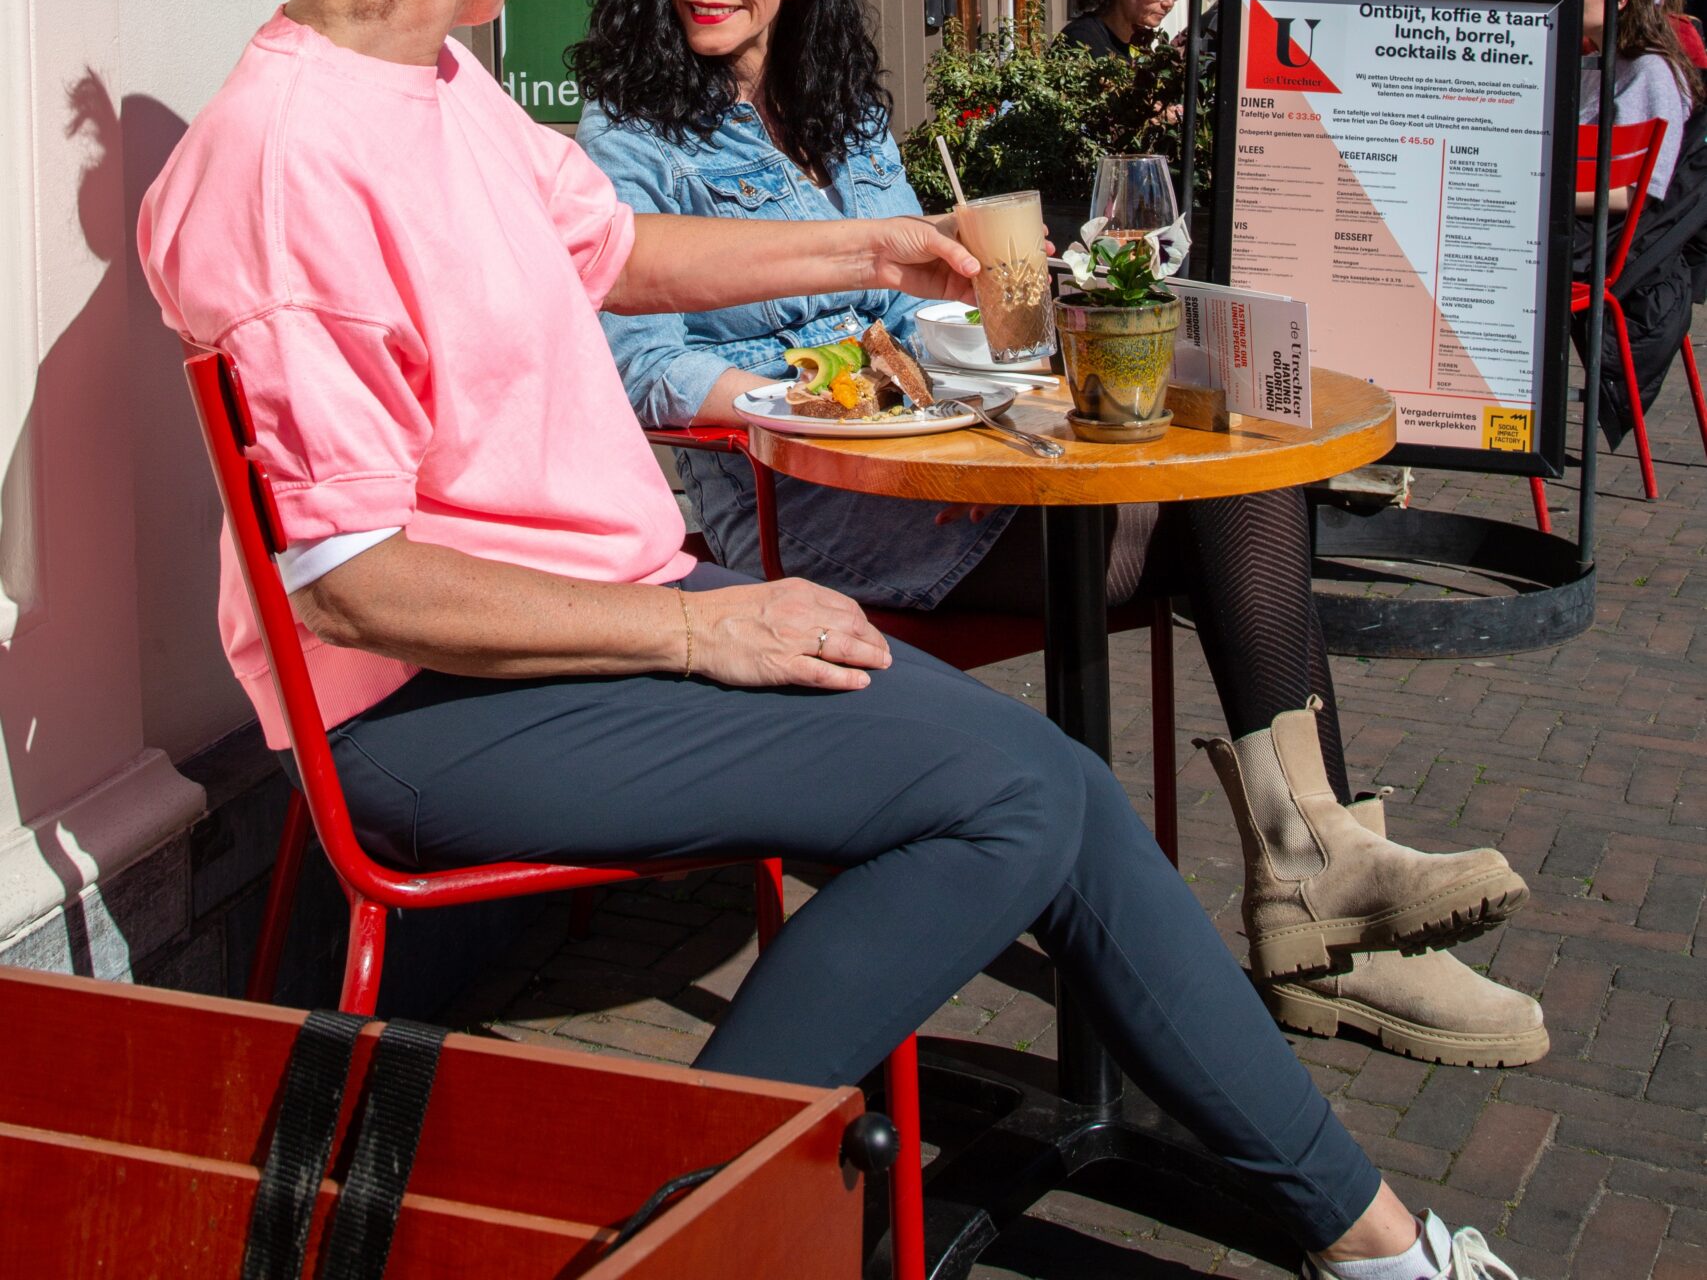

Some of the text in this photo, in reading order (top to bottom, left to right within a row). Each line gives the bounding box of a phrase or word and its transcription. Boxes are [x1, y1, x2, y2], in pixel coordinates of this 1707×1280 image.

[1360, 3, 1554, 30] Ontbijt, koffie & taart,
[1395, 24, 1515, 47] lunch, borrel,
[1274, 18, 1322, 68] U
[1375, 45, 1533, 65] cocktails & diner.
[1264, 75, 1323, 87] de Utrechter
[1241, 97, 1274, 109] DINER
[1240, 110, 1270, 120] Tafeltje
[1296, 113, 1321, 121] 33.50
[1408, 136, 1434, 145] 45.50
[1239, 145, 1264, 154] VLEES
[1450, 146, 1479, 155] LUNCH
[1339, 151, 1398, 162] VEGETARISCH
[1234, 222, 1248, 230] VIS
[1335, 232, 1373, 242] DESSERT
[1185, 296, 1193, 339] SANDWICH
[1191, 297, 1200, 346] SOURDOUGH
[1240, 339, 1246, 349] OF
[1290, 321, 1302, 418] de Utrechter
[1273, 351, 1282, 412] COLORFULL
[1266, 374, 1275, 411] LUNCH
[1282, 362, 1291, 414] HAVING A
[1401, 407, 1477, 420] Vergaderruimtes
[1418, 420, 1476, 430] werkplekken
